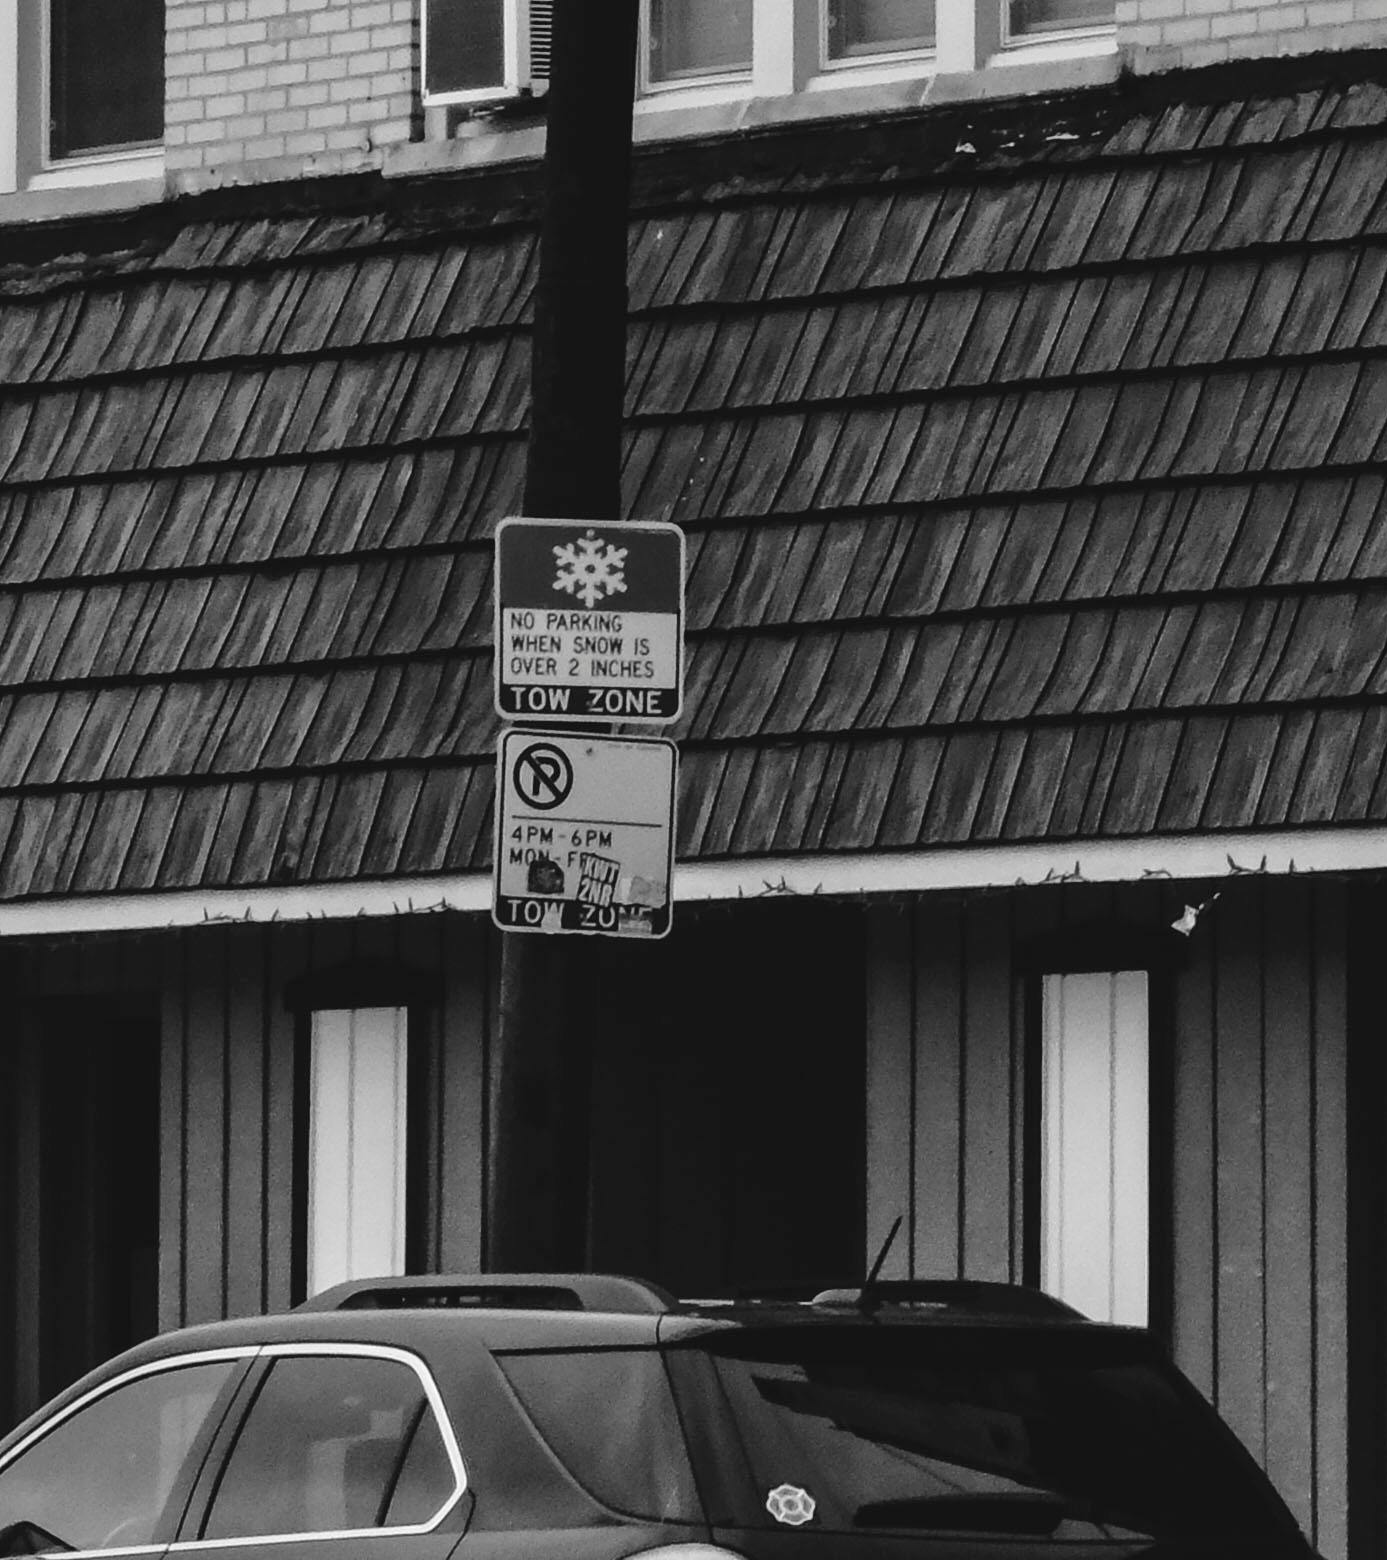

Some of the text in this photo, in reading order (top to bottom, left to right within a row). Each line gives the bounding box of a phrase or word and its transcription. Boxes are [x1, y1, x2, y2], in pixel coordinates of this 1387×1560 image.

[511, 612, 622, 632] NO PARKING
[512, 634, 650, 656] WHEN SNOW IS
[511, 657, 655, 678] OVER 2 INCHES
[510, 687, 662, 714] TOW ZONE
